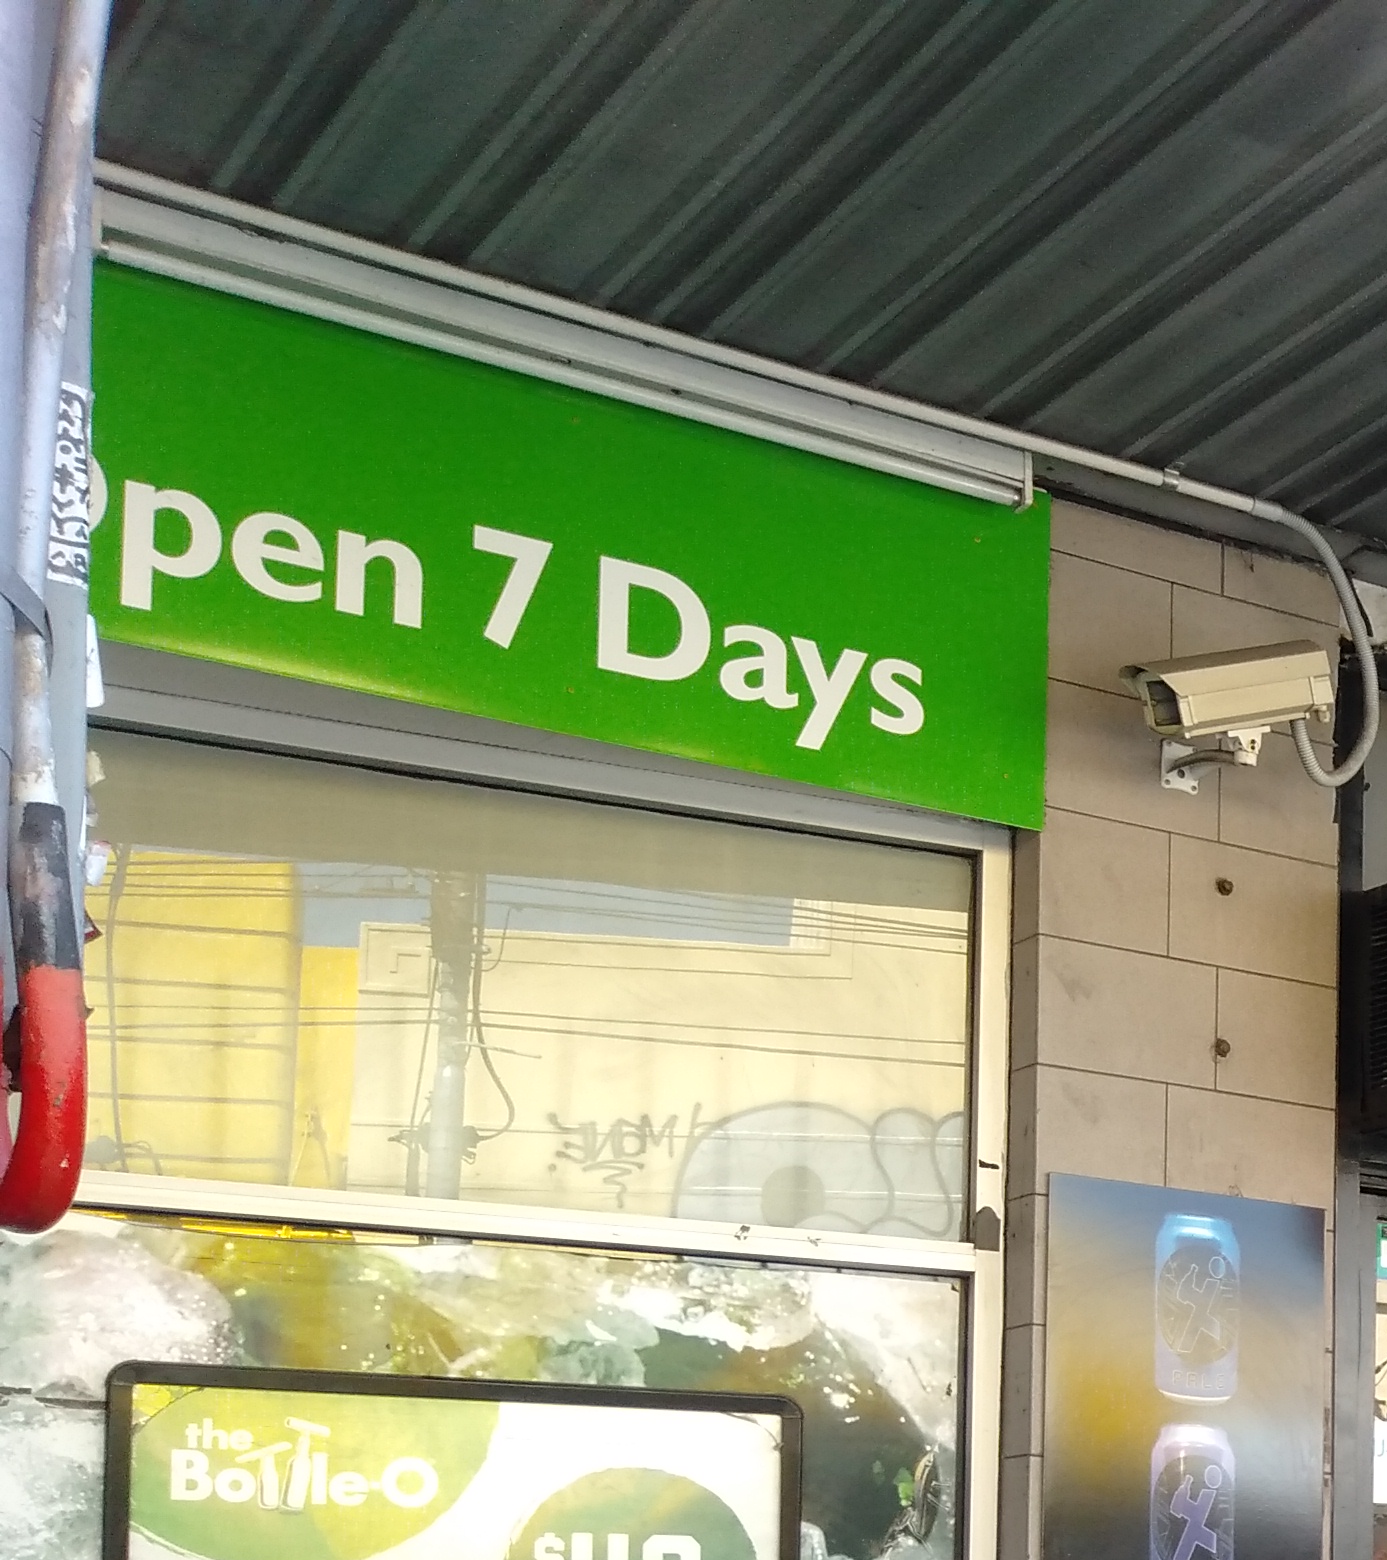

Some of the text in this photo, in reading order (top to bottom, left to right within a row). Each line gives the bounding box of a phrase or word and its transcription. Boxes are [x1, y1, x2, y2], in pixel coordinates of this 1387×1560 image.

[88, 454, 424, 630] pen
[473, 525, 552, 650] 7
[598, 555, 924, 750] Days
[1172, 1370, 1225, 1390] PALE
[185, 1420, 252, 1452] the
